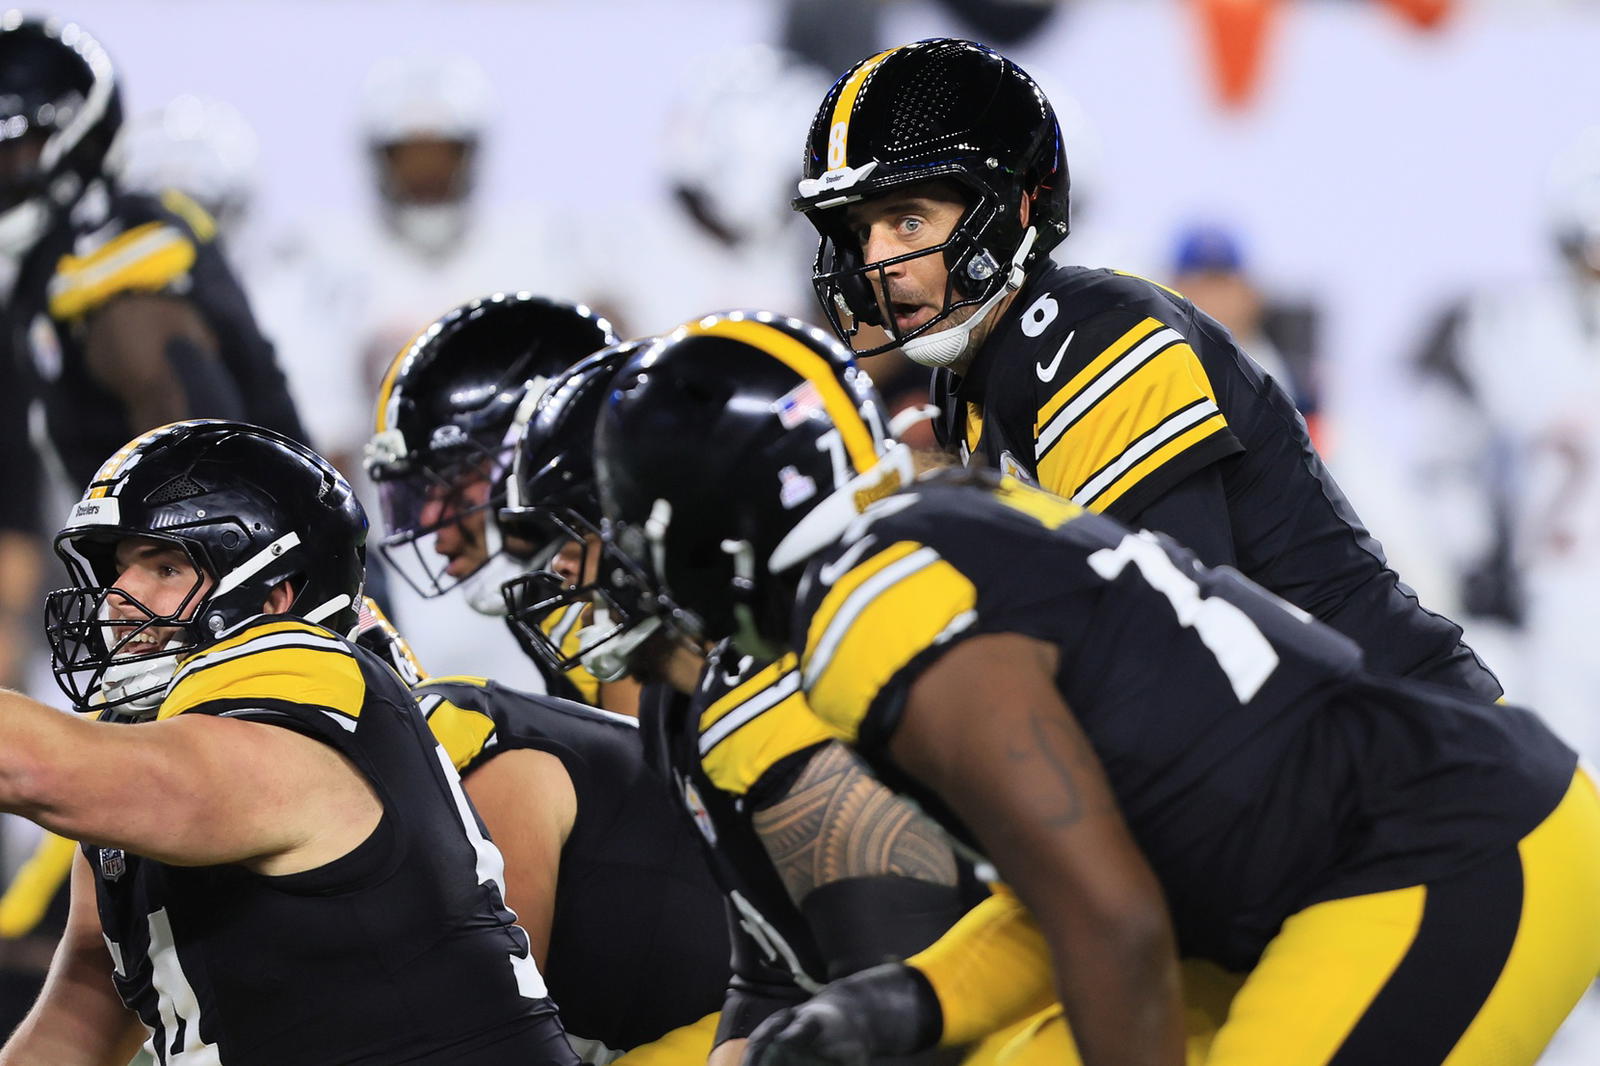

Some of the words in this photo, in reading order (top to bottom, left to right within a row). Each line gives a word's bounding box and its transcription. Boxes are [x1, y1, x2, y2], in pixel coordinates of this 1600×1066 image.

[828, 121, 847, 169] 8
[76, 502, 100, 518] Steelers
[104, 854, 122, 876] NFL
